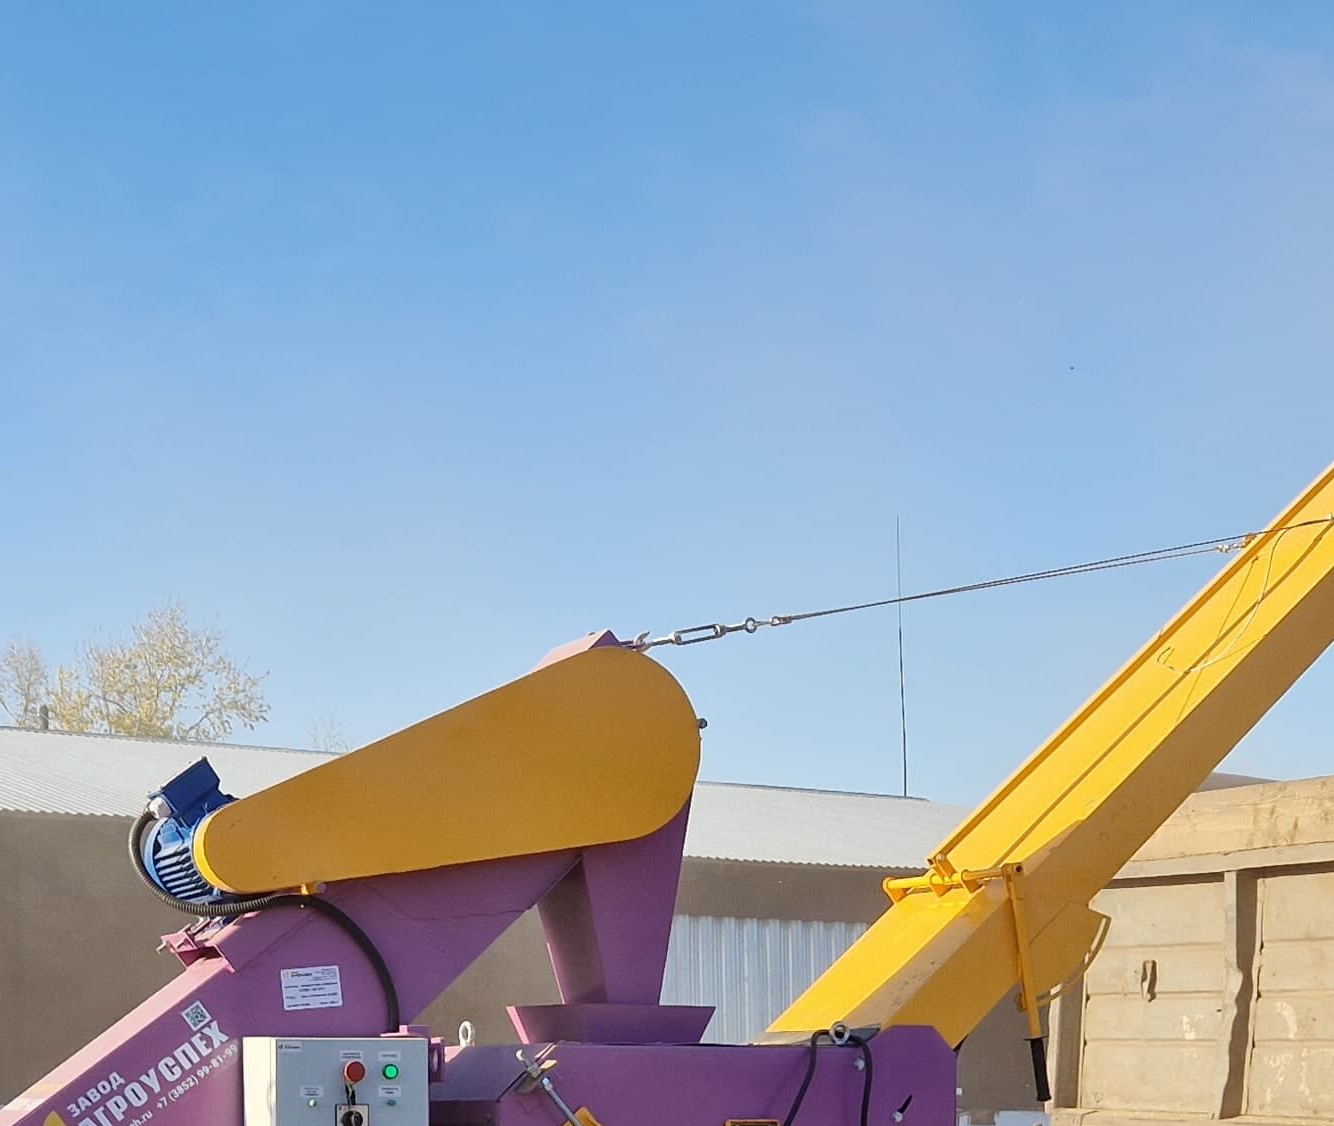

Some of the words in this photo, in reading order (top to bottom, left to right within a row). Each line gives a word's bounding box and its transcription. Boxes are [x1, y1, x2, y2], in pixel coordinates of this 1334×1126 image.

[67, 1071, 126, 1117] ЗАВОД
[157, 1097, 168, 1109] +7
[169, 1075, 199, 1102] (3852)
[197, 1043, 238, 1078] 99-81-99
